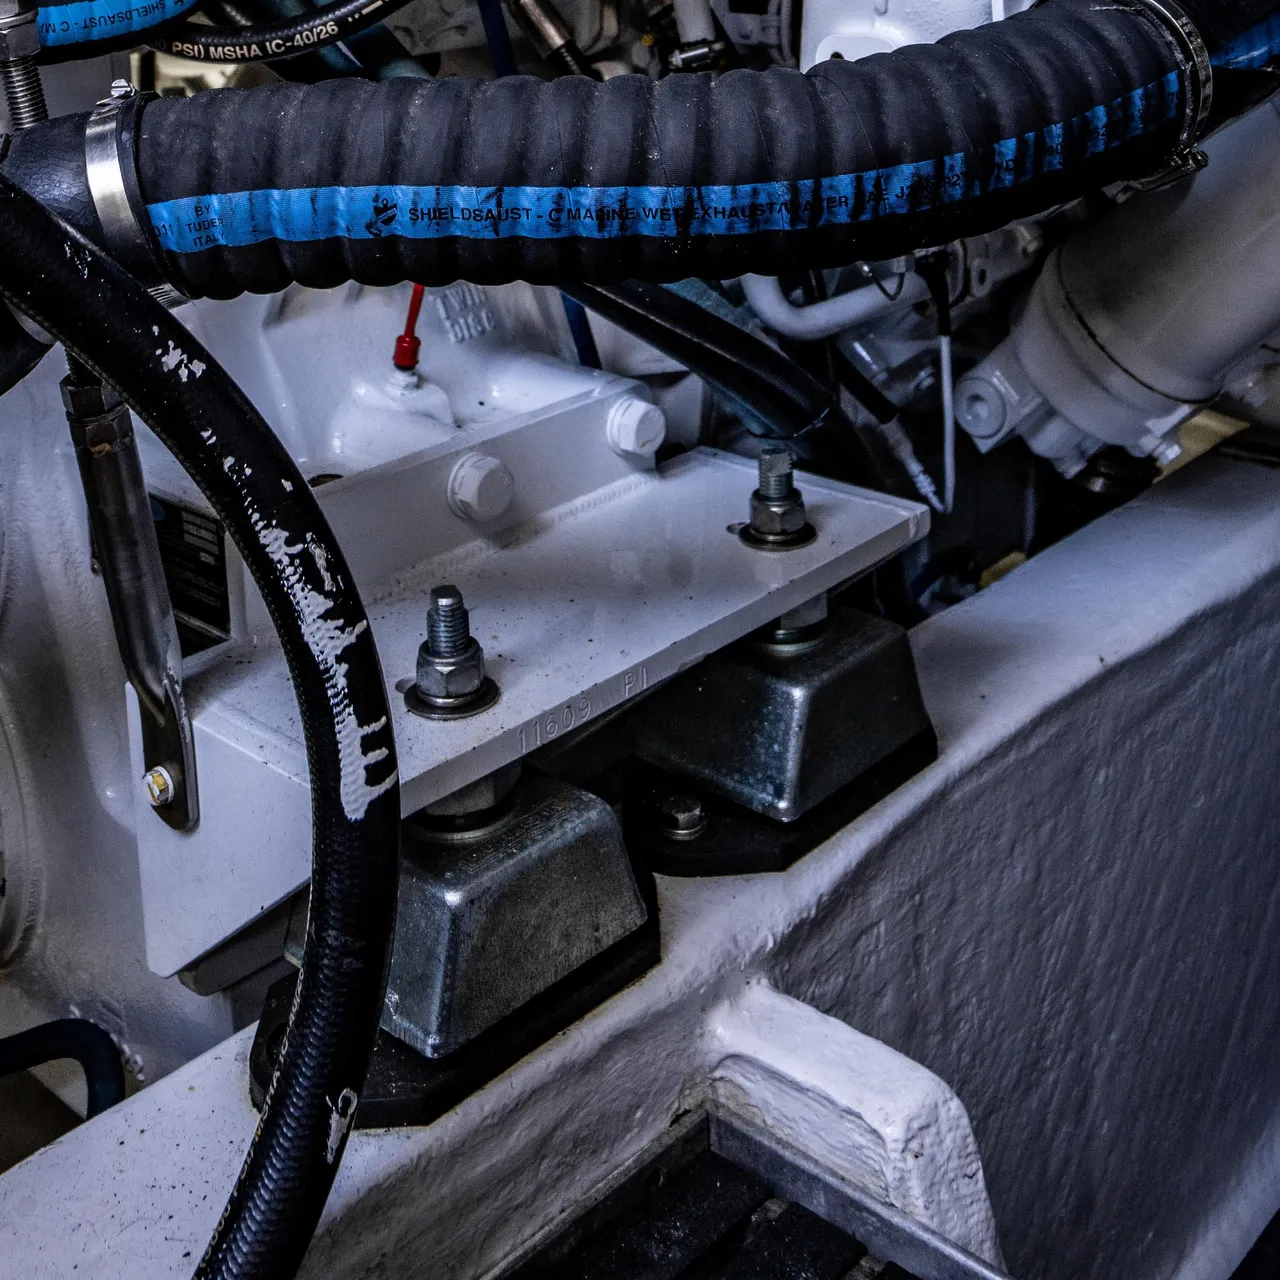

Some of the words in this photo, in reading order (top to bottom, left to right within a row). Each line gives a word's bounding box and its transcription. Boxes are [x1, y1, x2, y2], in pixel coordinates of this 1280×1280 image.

[82, 0, 166, 29] SHIELDSAUST
[171, 41, 205, 60] PSI)
[208, 43, 263, 60] MSHA
[265, 21, 339, 55] IC-40/26
[193, 203, 211, 218] BY
[408, 206, 533, 222] SHIELDSAUST
[518, 696, 591, 753] 11609
